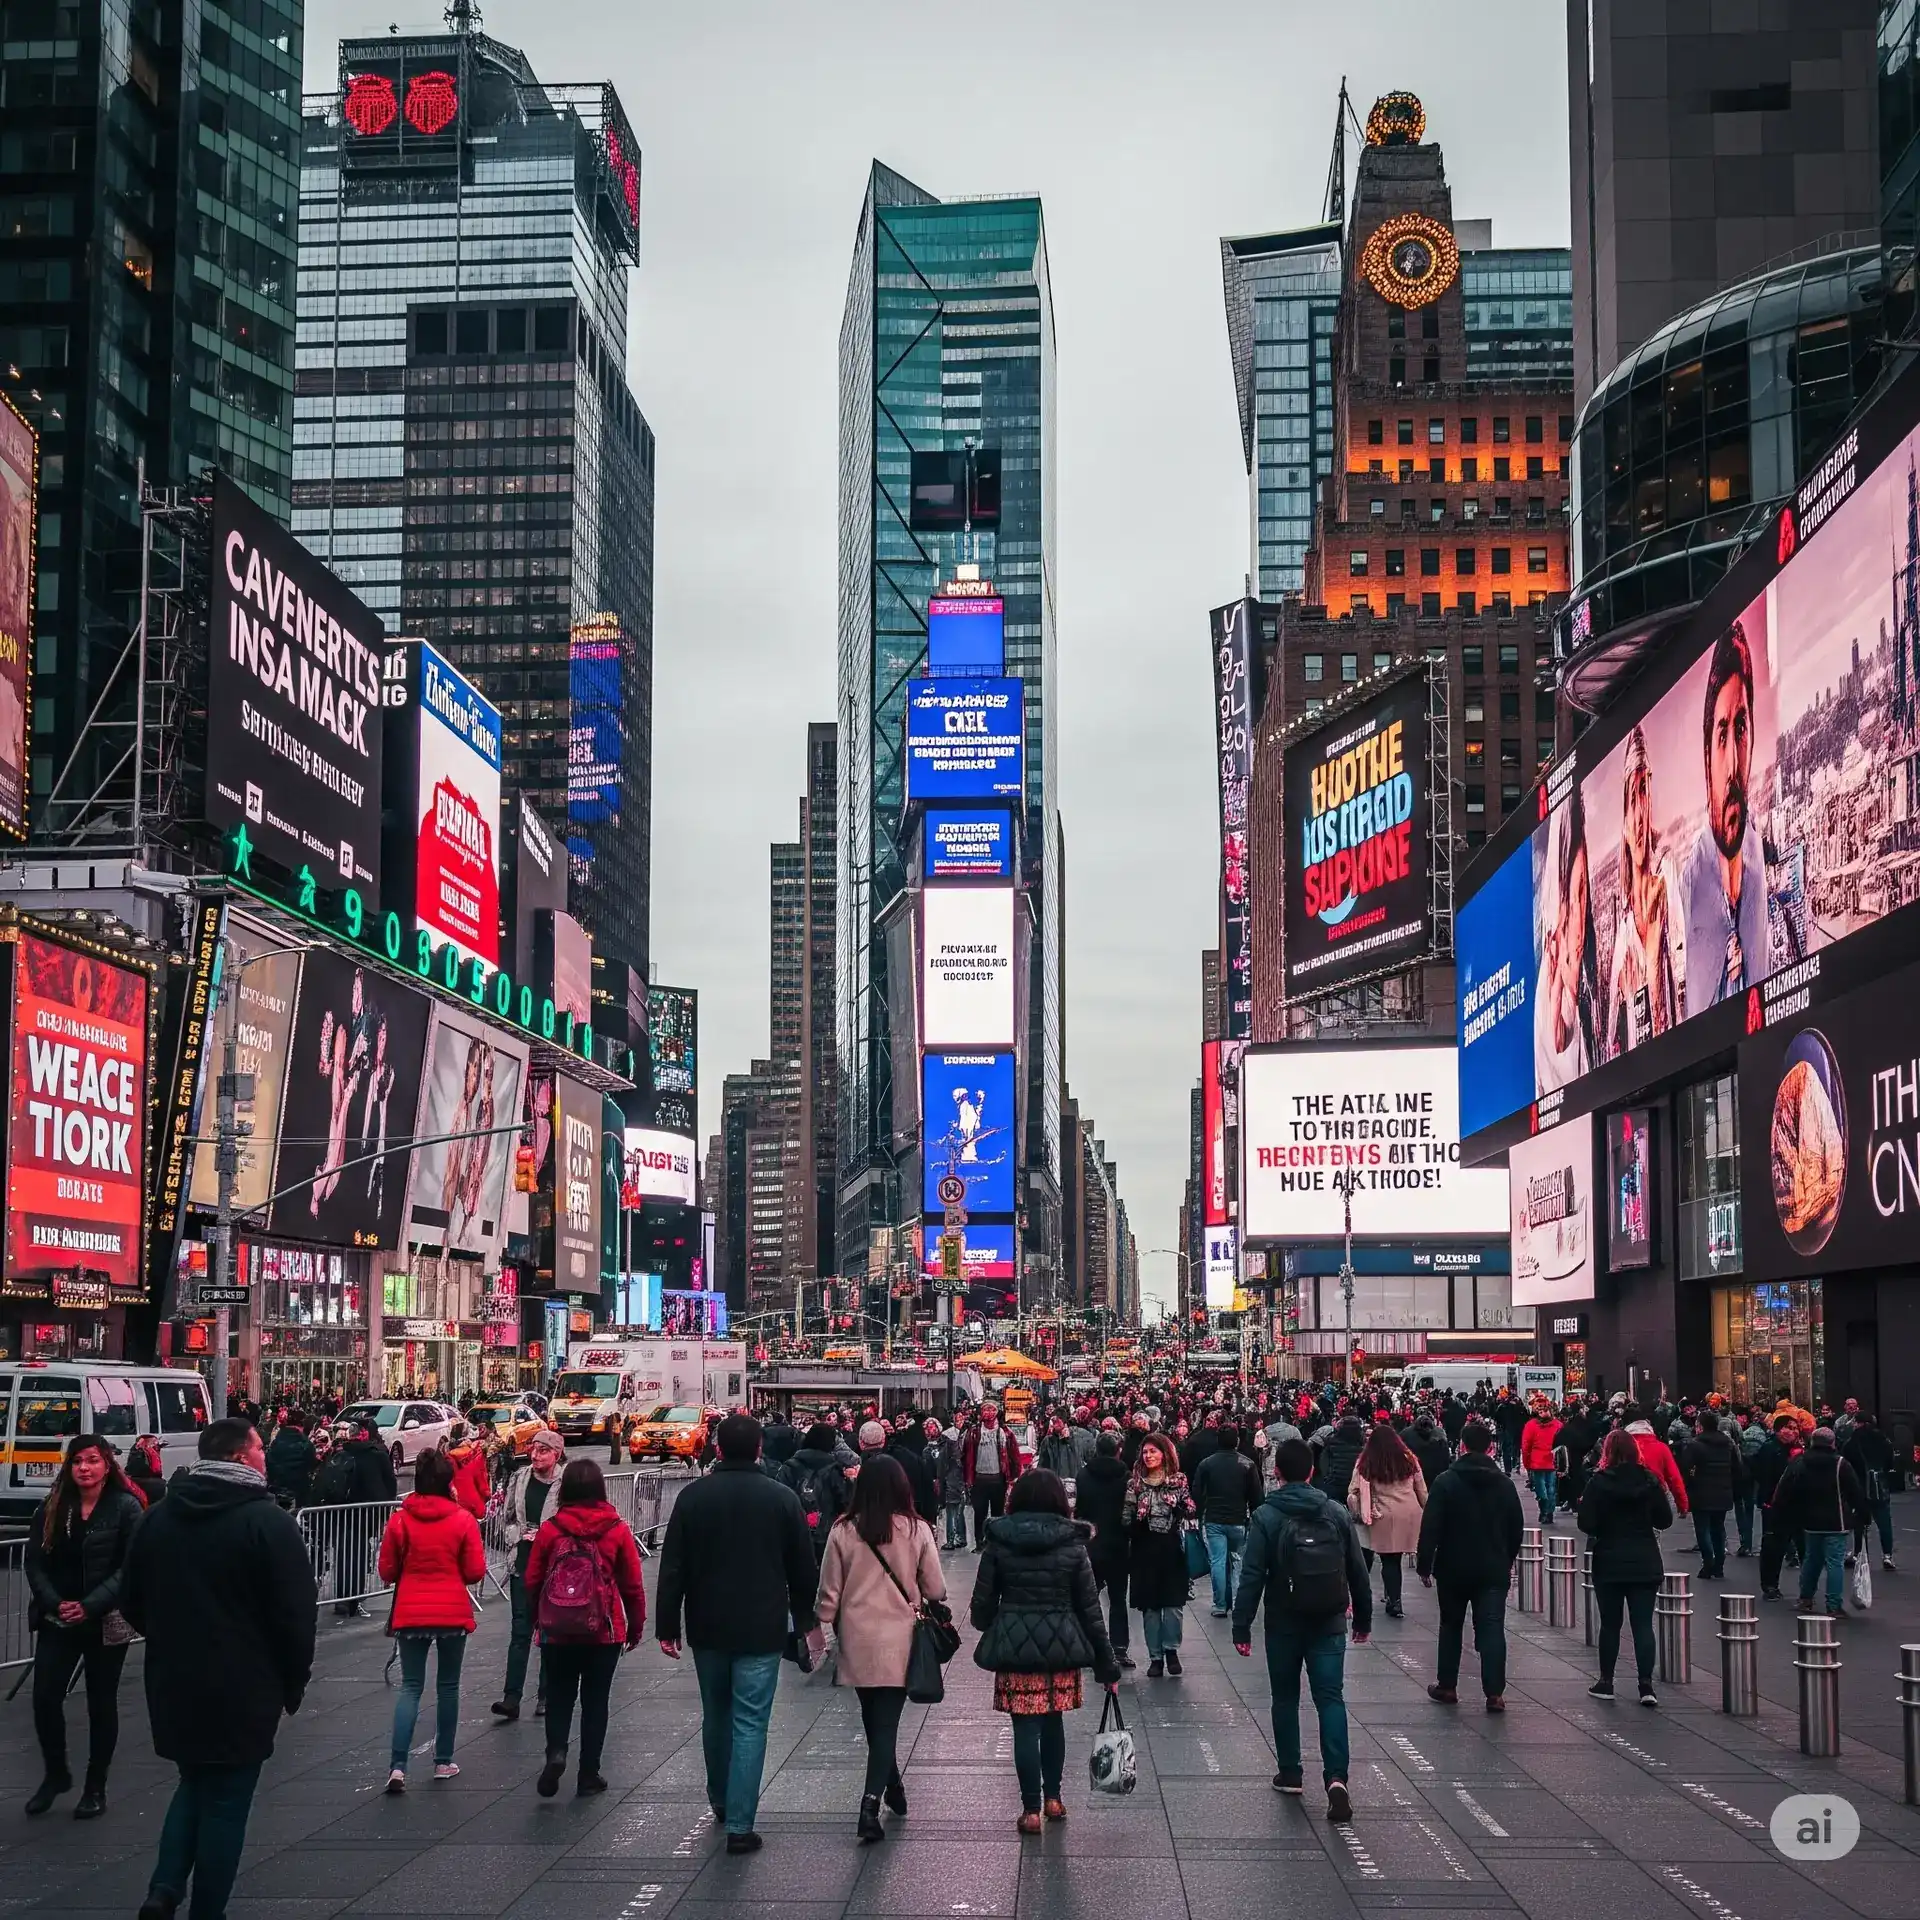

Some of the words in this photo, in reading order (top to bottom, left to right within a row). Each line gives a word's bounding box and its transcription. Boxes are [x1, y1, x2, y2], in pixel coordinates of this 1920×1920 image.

[28, 1035, 134, 1116] WEACE
[1292, 1095, 1334, 1116] THE
[29, 1100, 132, 1175] TIORK
